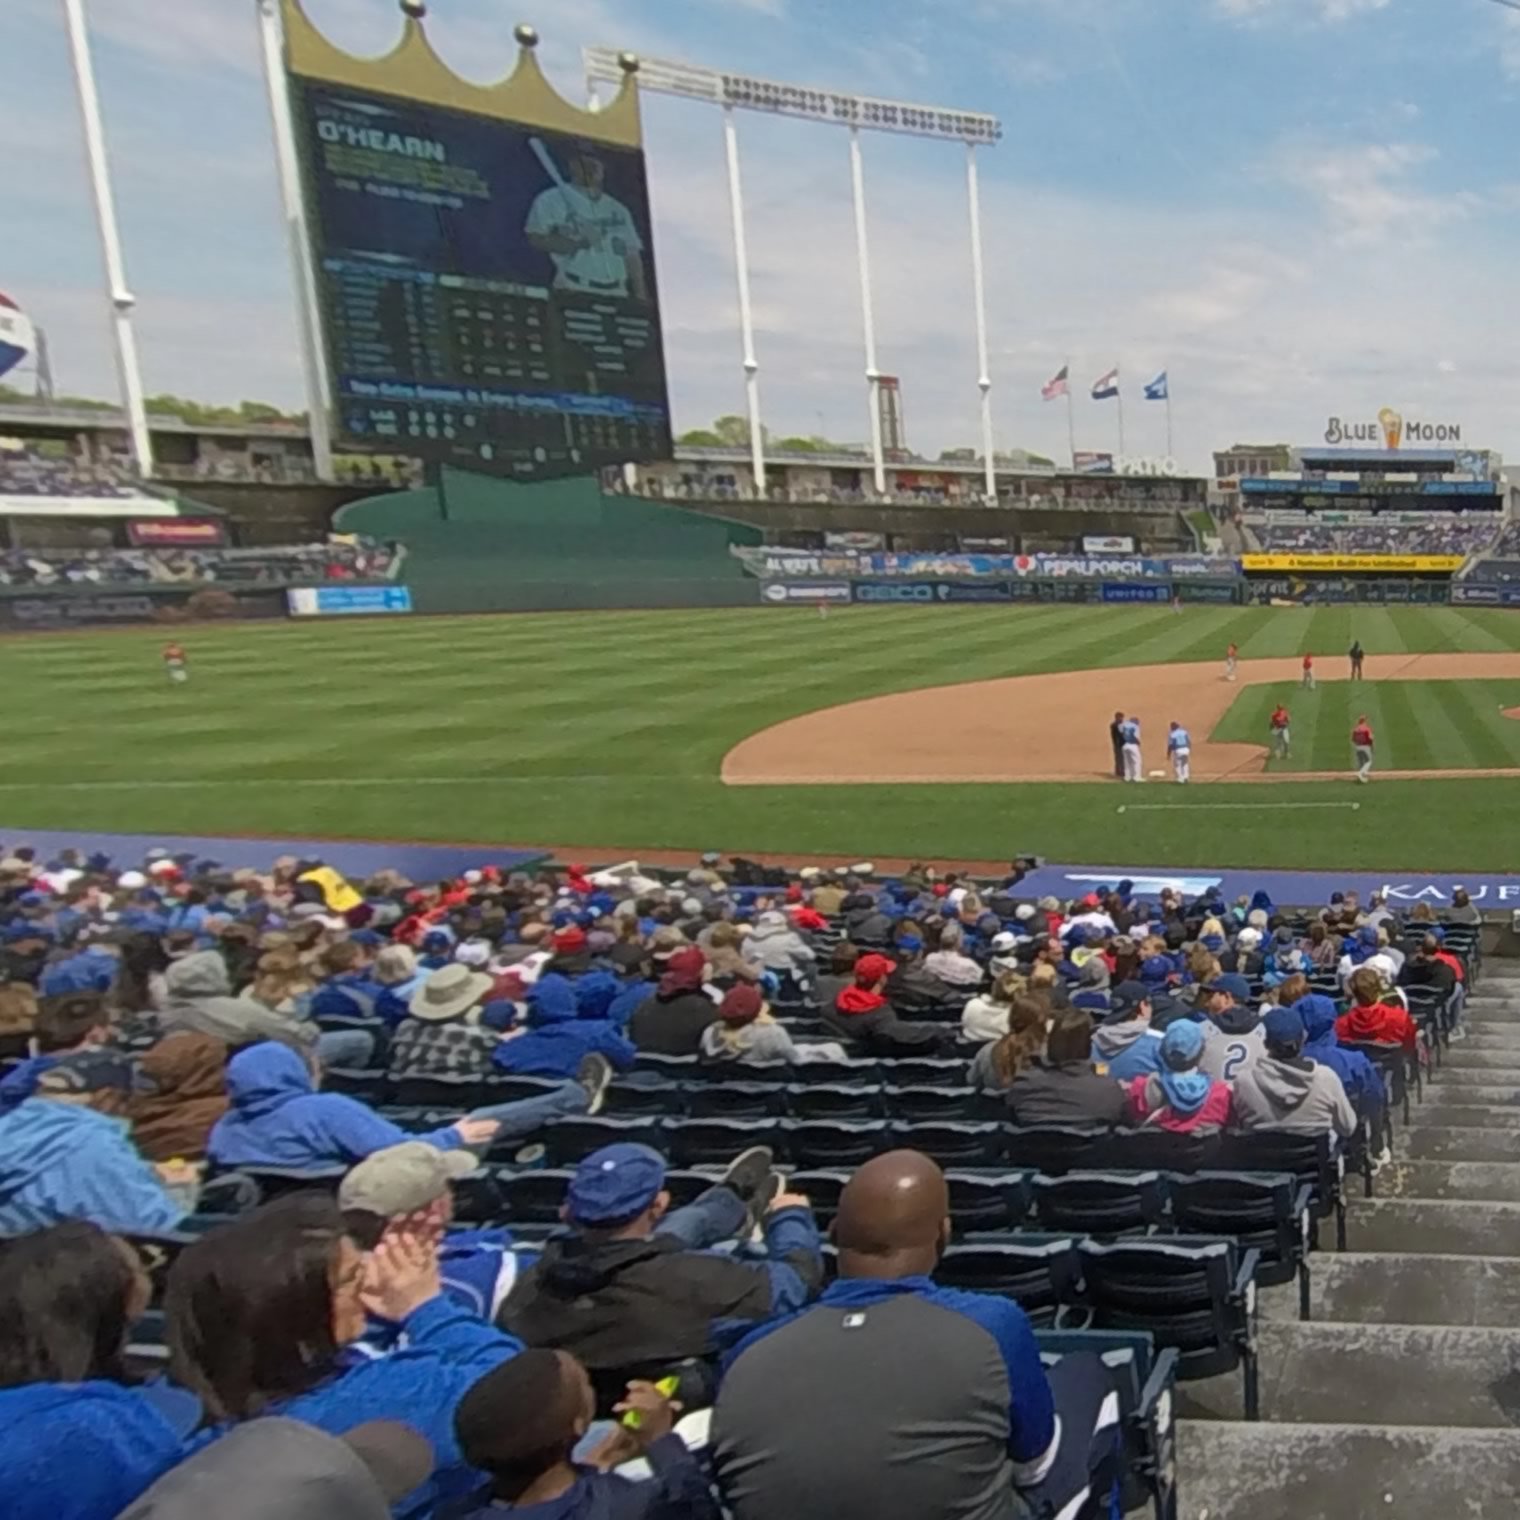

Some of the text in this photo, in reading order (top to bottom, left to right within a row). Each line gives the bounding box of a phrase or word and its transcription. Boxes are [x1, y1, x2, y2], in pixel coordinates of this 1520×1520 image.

[317, 120, 445, 162] O'HEARN
[1324, 417, 1460, 444] BLUE MOON
[856, 585, 932, 600] GEICO
[1223, 1043, 1248, 1081] 2
